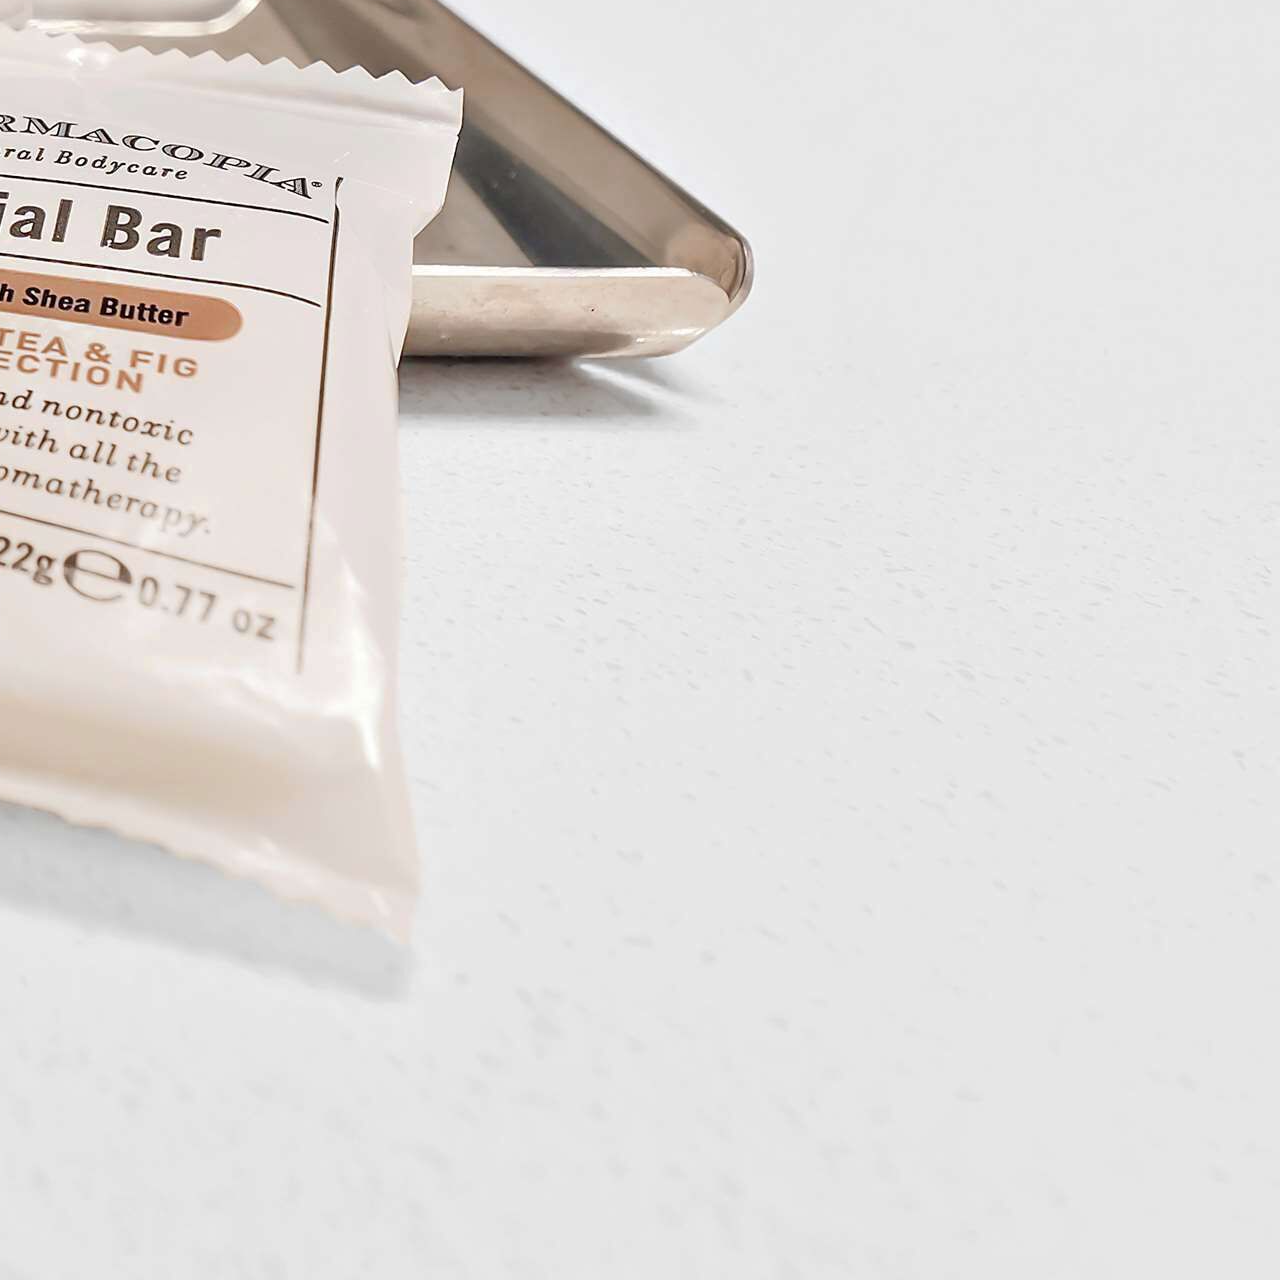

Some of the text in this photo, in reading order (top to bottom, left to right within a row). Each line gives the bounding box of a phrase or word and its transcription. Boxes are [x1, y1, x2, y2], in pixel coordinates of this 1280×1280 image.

[55, 149, 189, 182] Bodycare
[100, 204, 222, 262] Bar
[22, 286, 91, 314] Shea
[99, 295, 191, 328] Butter
[85, 341, 114, 366] &
[130, 350, 200, 379] FIG
[40, 399, 195, 447] nontoxic
[69, 438, 117, 468] all
[126, 450, 183, 485] the
[138, 576, 218, 623] 0.77
[232, 608, 277, 641] oz
